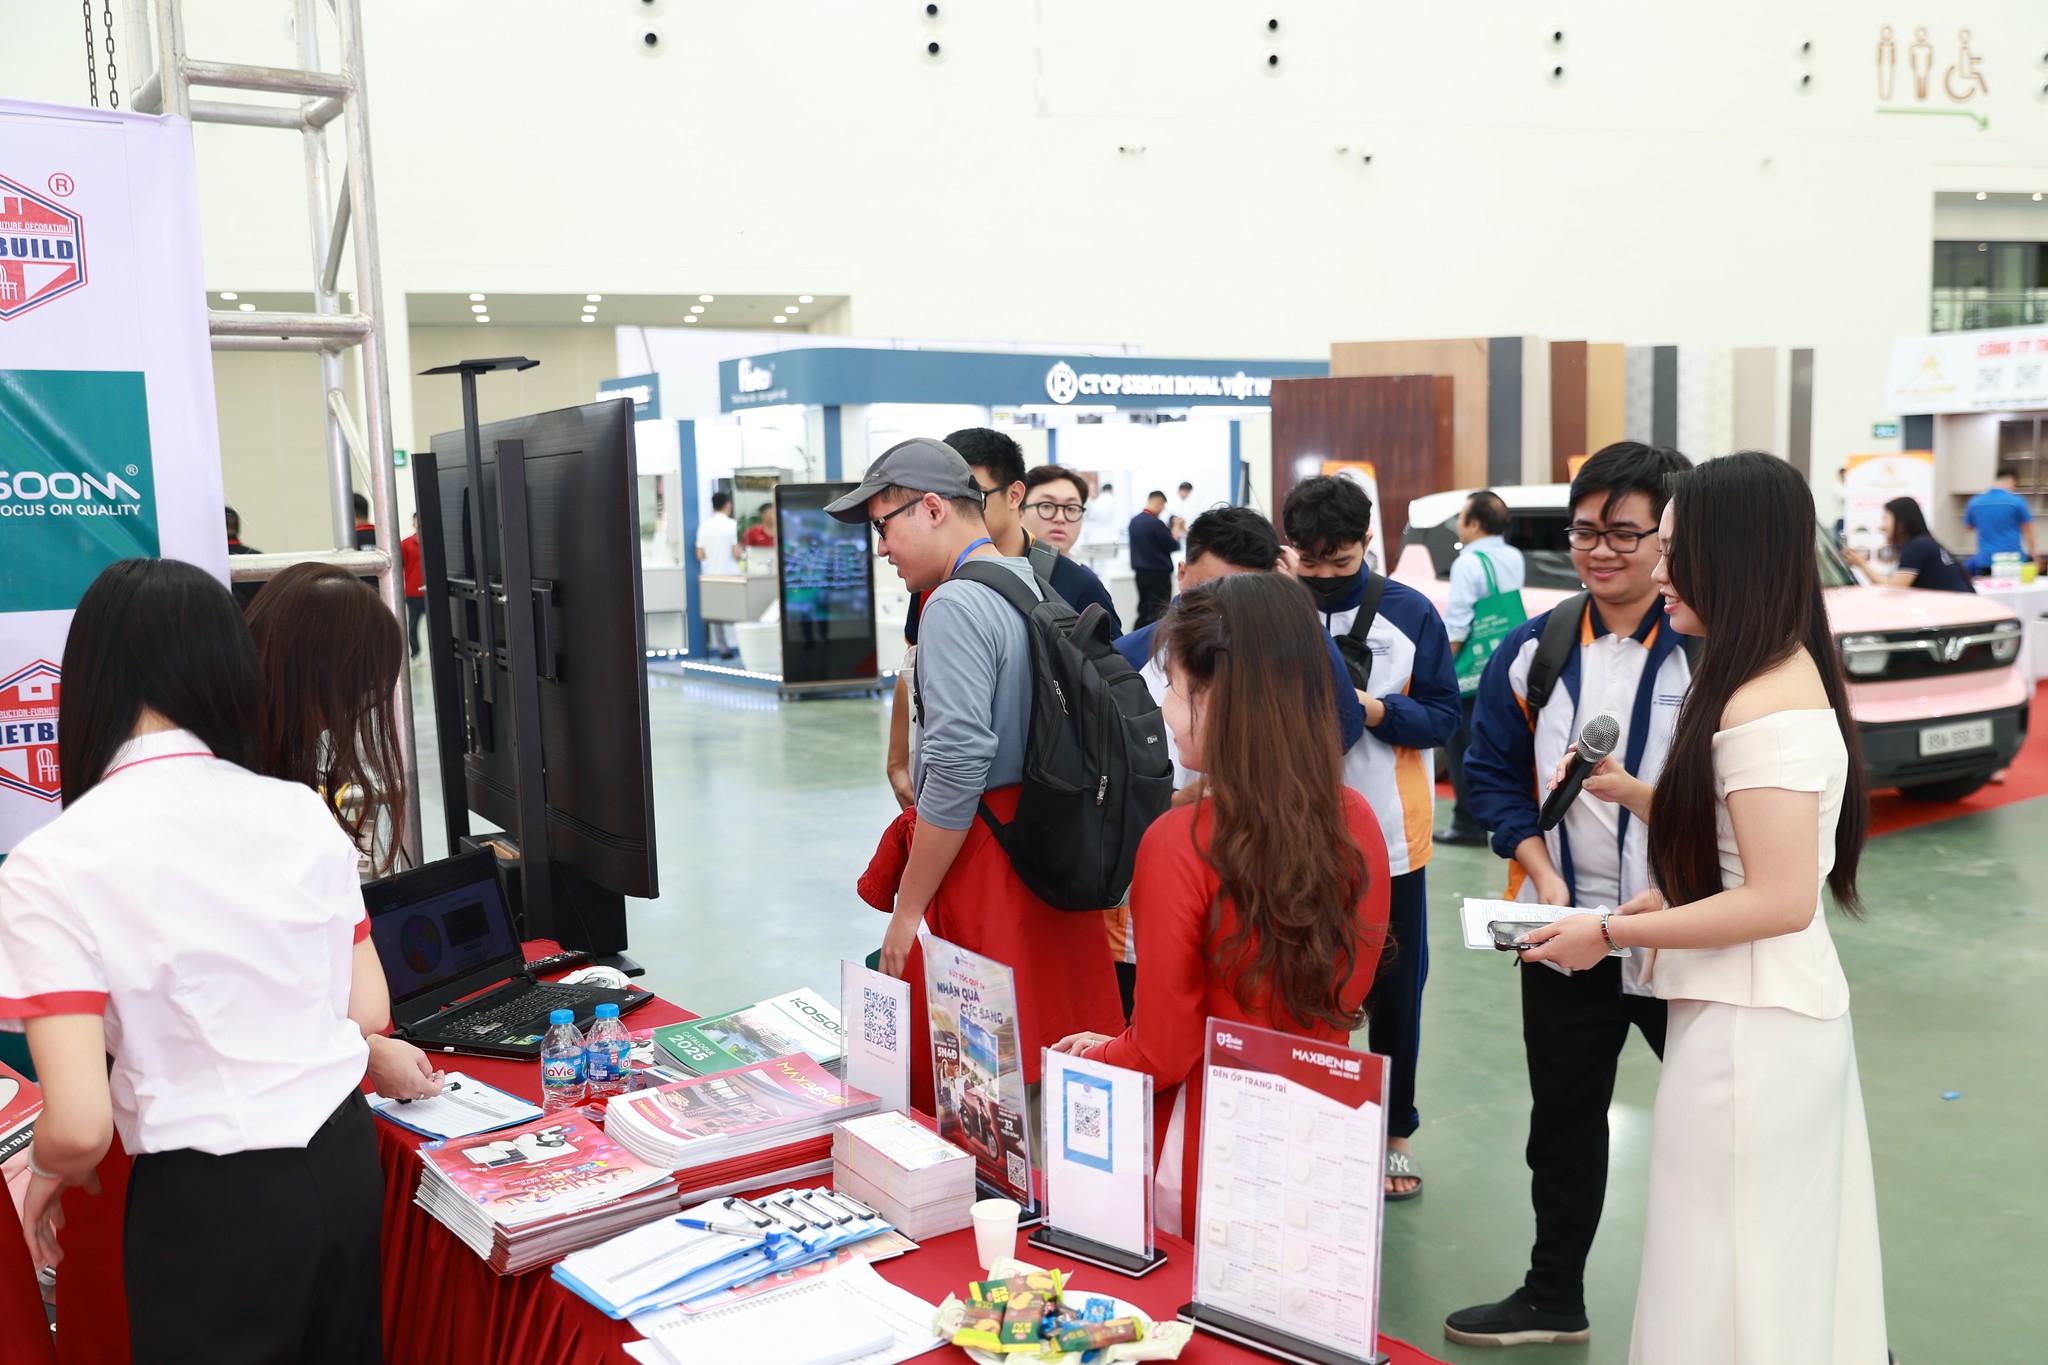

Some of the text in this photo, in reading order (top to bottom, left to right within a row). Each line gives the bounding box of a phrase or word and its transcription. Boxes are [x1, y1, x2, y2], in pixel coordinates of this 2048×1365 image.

[25, 223, 69, 232] DECORATION
[1175, 376, 1221, 397] ROYAL
[50, 504, 73, 516] ON
[76, 504, 141, 517] QUALITY
[936, 981, 961, 999] NHẬN
[668, 1034, 710, 1061] 2025
[682, 1031, 717, 1057] CATALOGUE
[545, 1065, 575, 1077] laVie
[1244, 1076, 1272, 1090] TRANG
